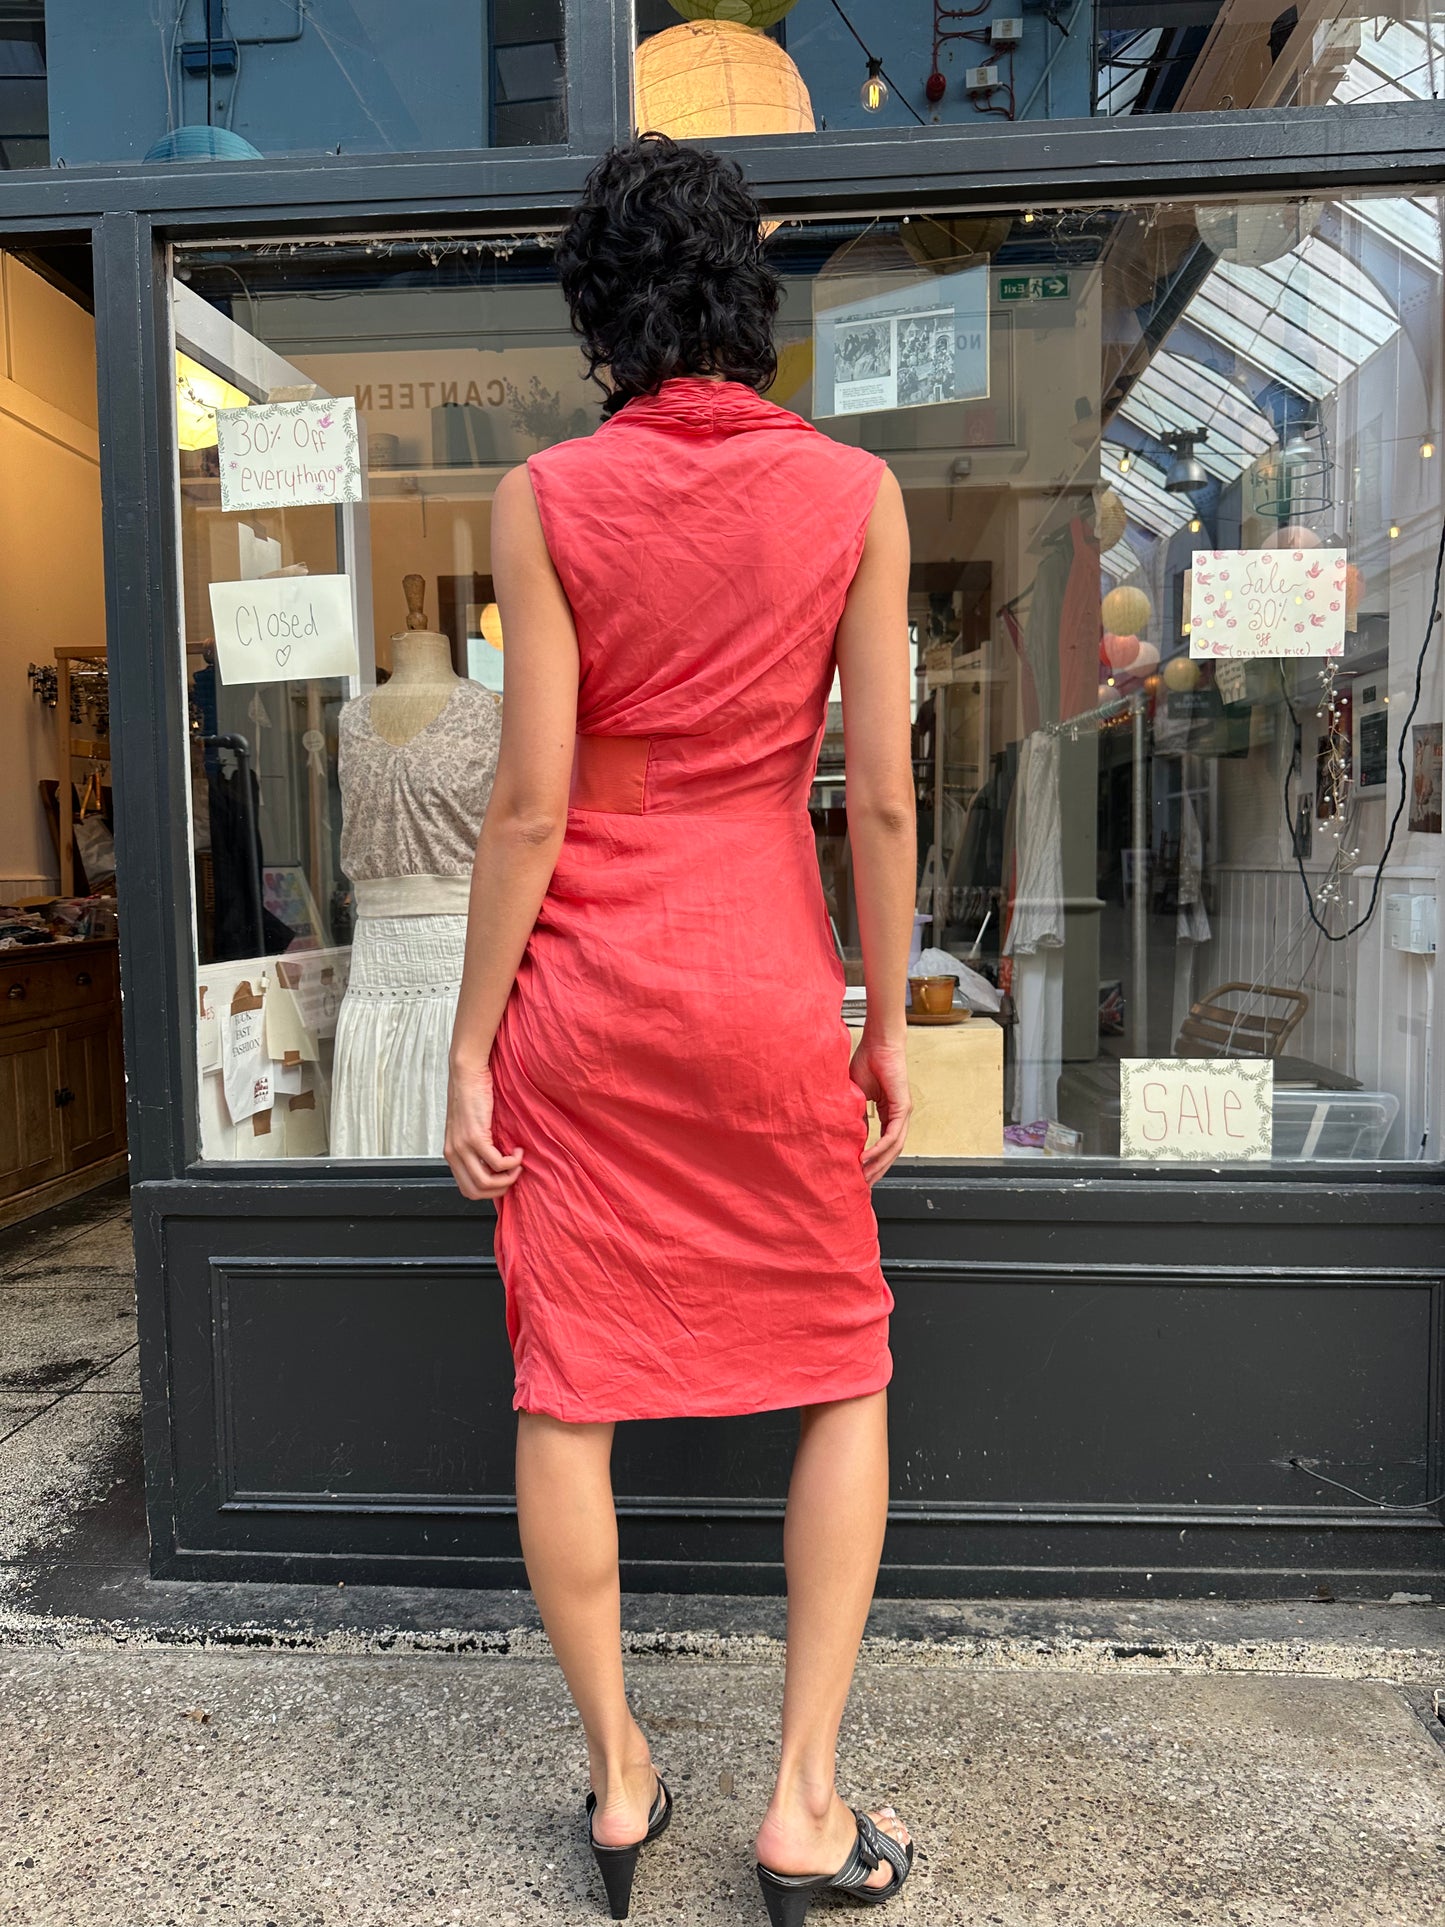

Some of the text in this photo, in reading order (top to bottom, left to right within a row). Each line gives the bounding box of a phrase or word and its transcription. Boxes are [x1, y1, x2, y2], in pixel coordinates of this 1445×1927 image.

[231, 419, 282, 456] 30%
[241, 463, 337, 497] everything
[1240, 560, 1305, 596] Sale
[235, 602, 319, 647] Closed
[1247, 597, 1288, 631] 30%
[1255, 632, 1272, 647] off
[232, 1037, 261, 1058] FASHION
[235, 1025, 252, 1040] FAST
